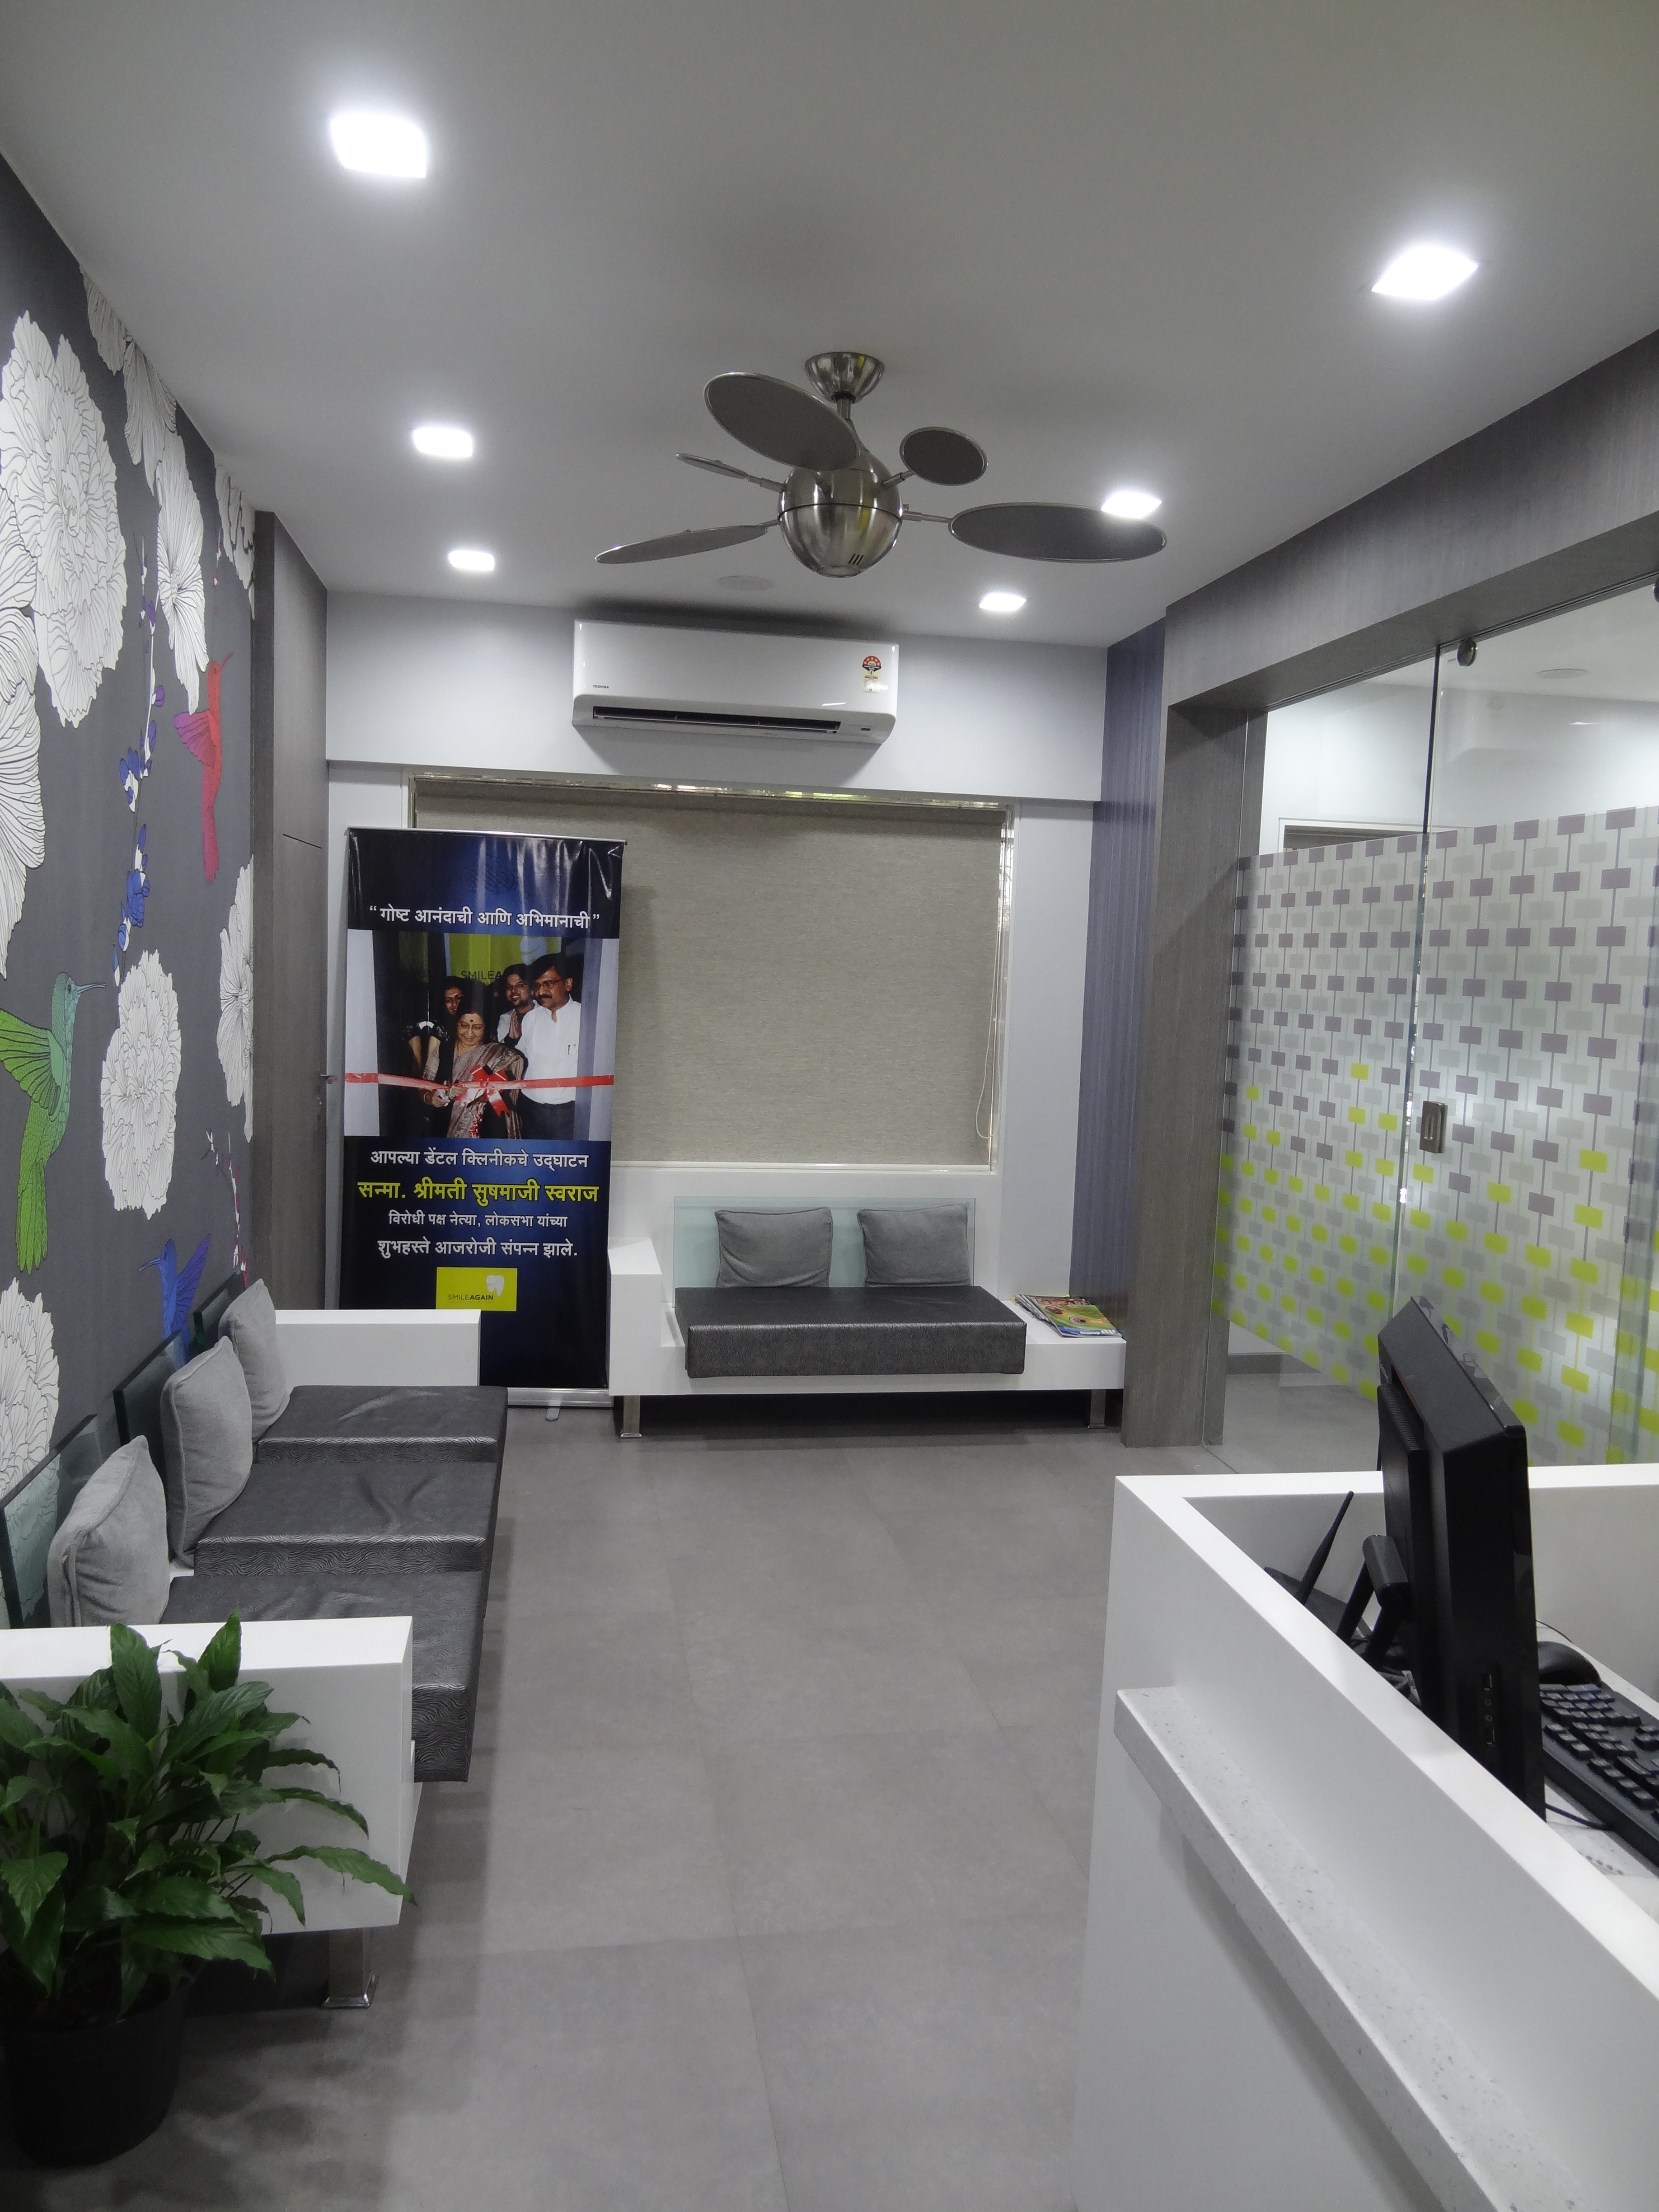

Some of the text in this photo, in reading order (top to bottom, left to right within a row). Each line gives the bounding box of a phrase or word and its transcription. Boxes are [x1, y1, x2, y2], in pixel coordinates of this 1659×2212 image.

[414, 907, 473, 924] आनंदाची
[477, 908, 512, 925] आणि
[460, 970, 501, 979] SMILEA
[370, 1151, 420, 1164] आपल्या
[424, 1147, 458, 1165] डेंटल
[462, 1148, 529, 1166] क्लिनीकचे
[357, 1176, 599, 1207] सन्मा. श्रीमती सुषमाजी स्वराज
[389, 1209, 568, 1227] विरोधी पक्ष नेत्या, लोकसभा यांच्या
[377, 1236, 577, 1259] शुभहस्ते आजरोजी संपन्न झाले.
